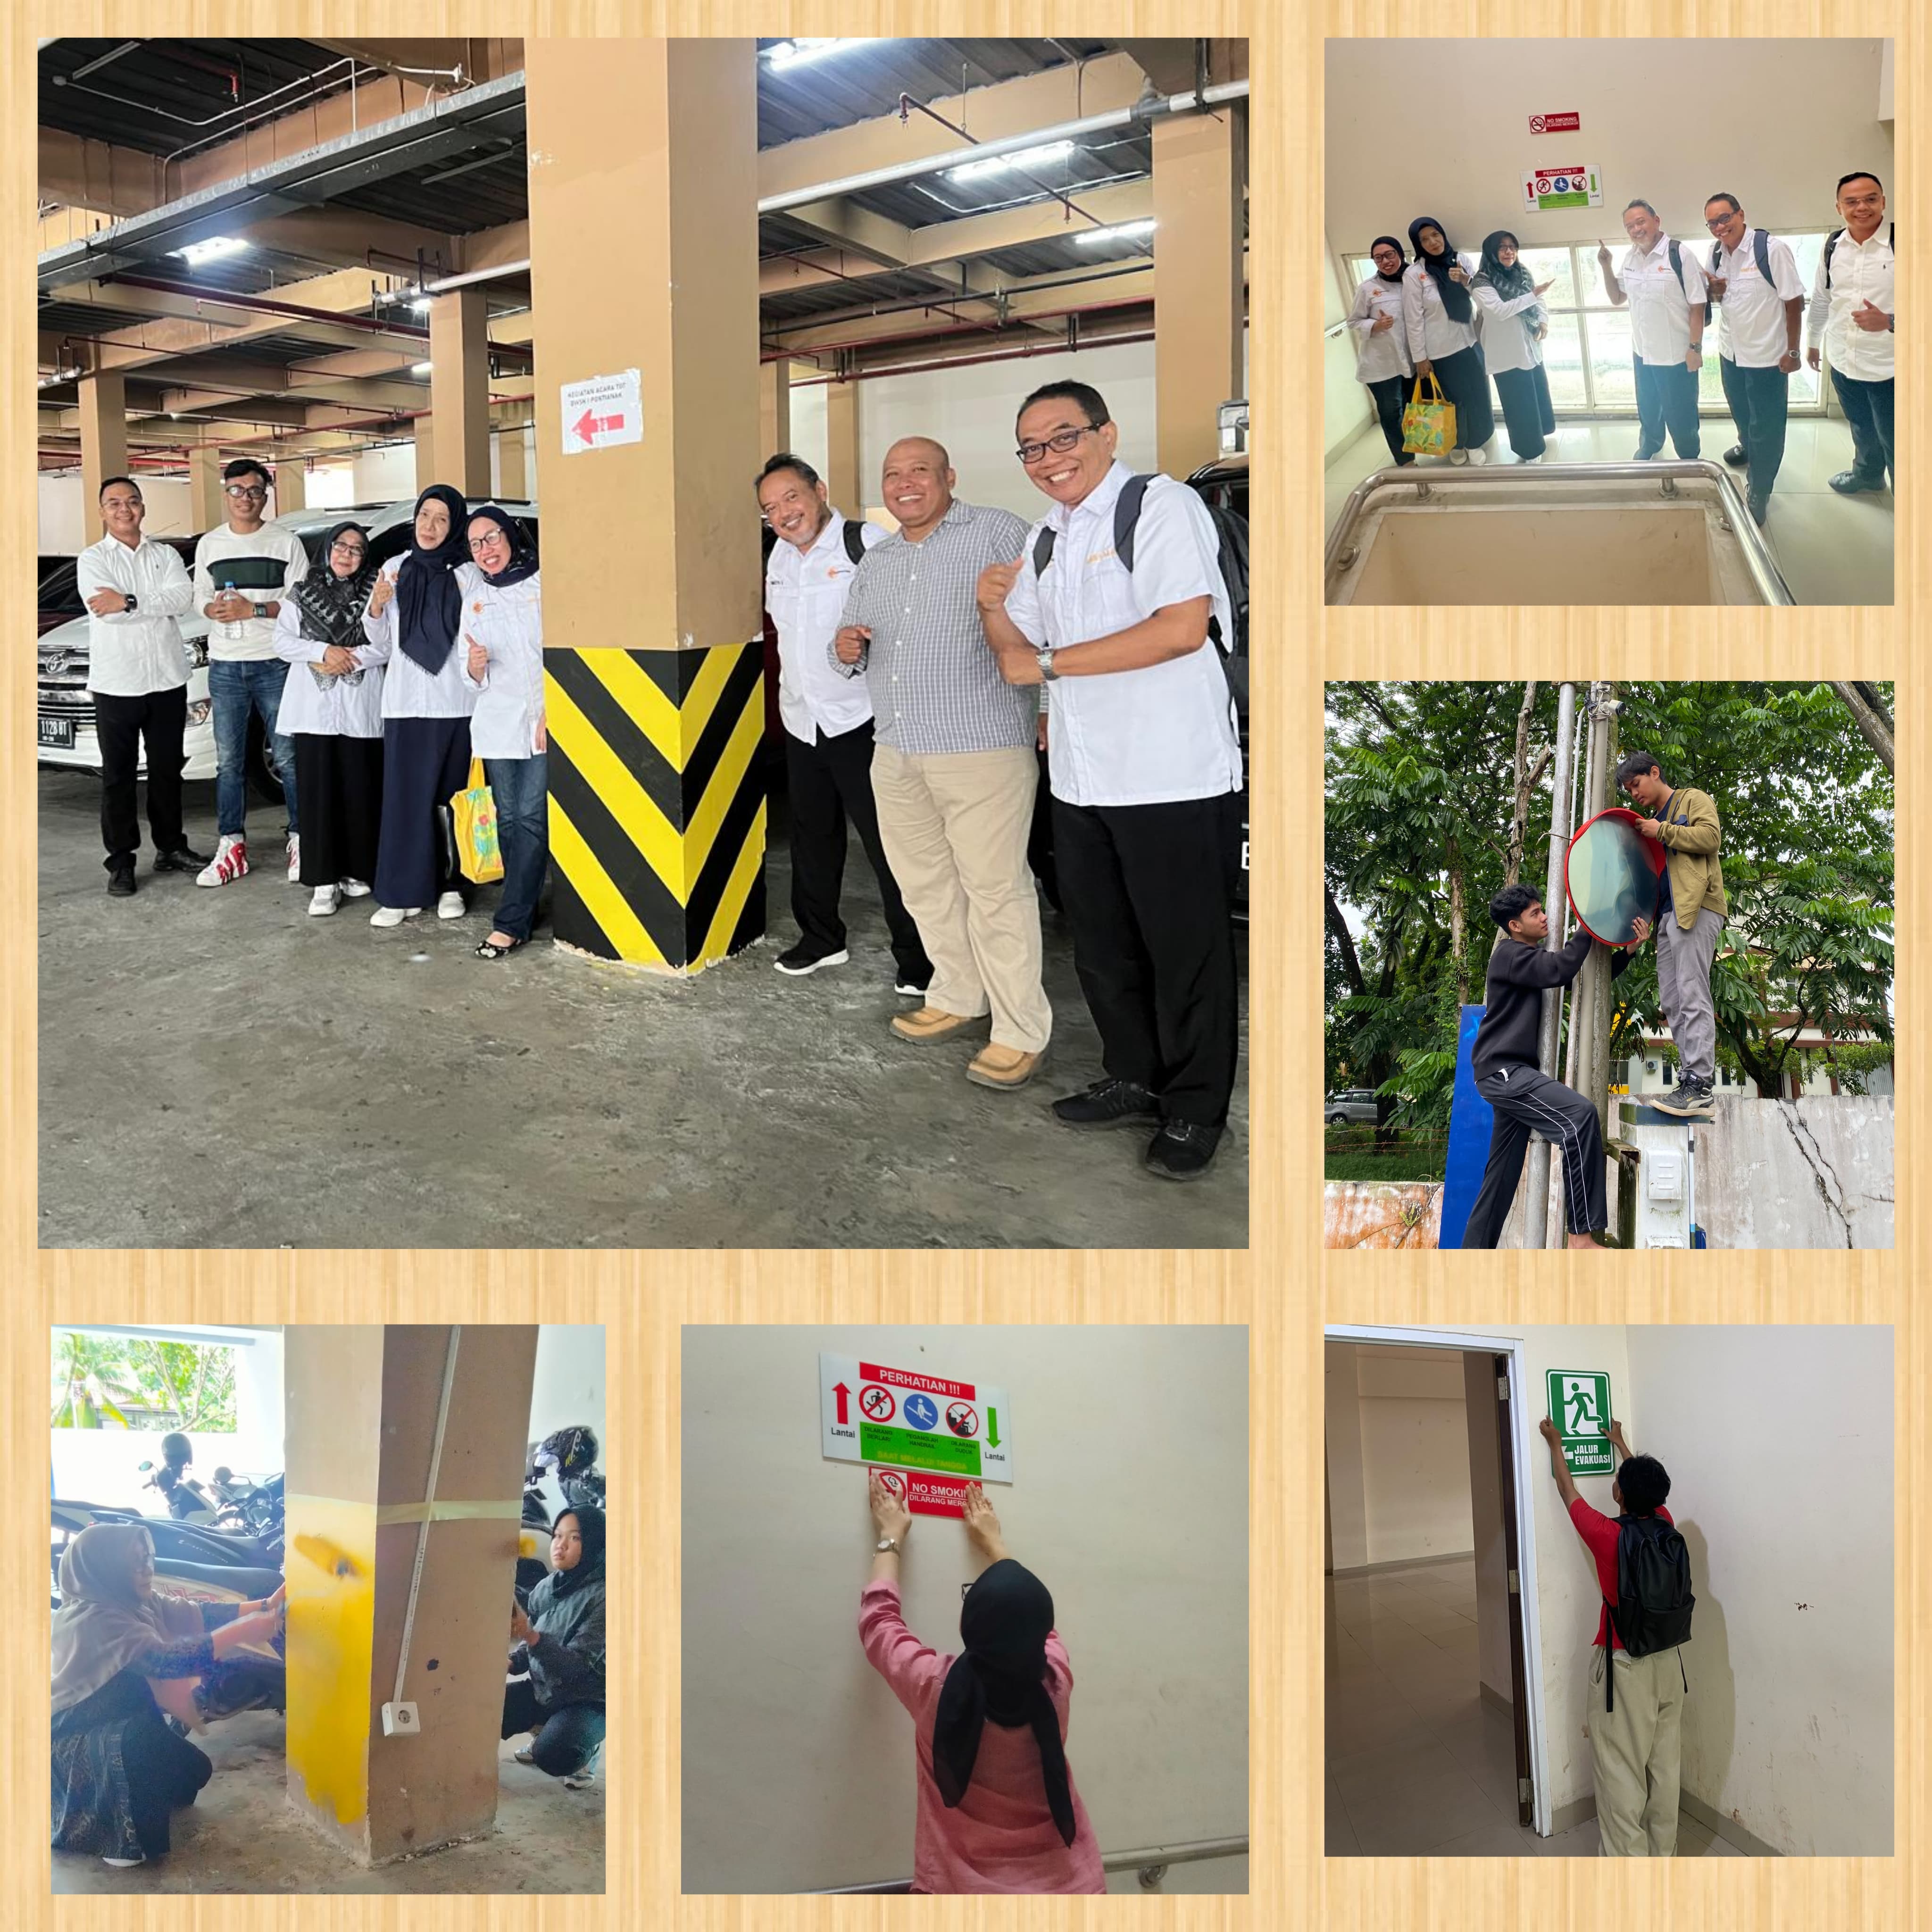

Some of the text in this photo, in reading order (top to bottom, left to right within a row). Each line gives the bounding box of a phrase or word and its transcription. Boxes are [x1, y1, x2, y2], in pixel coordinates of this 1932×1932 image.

[880, 1369, 960, 1395] PERHATIAN !!!
[831, 1427, 855, 1438] Lantai
[864, 1426, 893, 1435] DILARANG
[867, 1434, 891, 1442] BERLARI
[951, 1440, 976, 1449] DILARANG
[1574, 1445, 1598, 1455] JALUR
[985, 1451, 1005, 1462] Lantai
[1575, 1454, 1610, 1465] EVAKUASI
[912, 1482, 966, 1499] NO SMOKI
[909, 1494, 946, 1505] DILARANG
